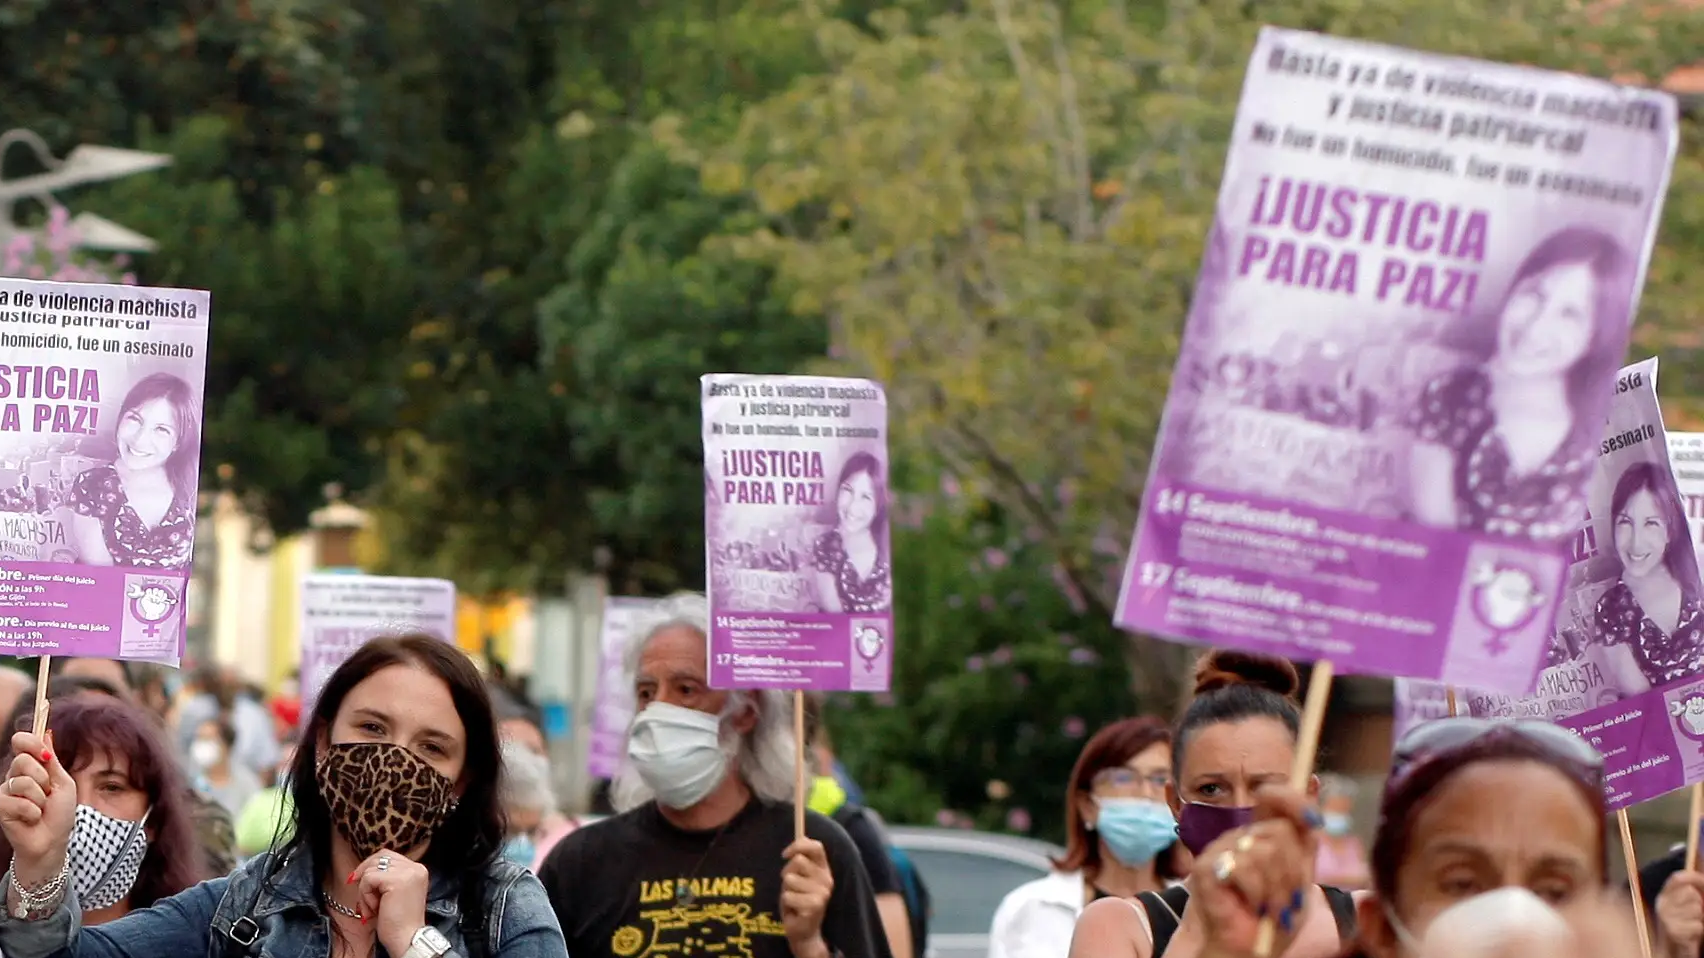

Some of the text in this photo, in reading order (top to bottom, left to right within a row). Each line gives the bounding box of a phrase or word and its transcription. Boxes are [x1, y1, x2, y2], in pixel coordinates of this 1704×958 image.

[1267, 44, 1662, 132] Basta ya de violencia machista
[1327, 96, 1585, 155] y justicia patriarcal
[1249, 175, 1492, 264] ¡JUSTICIA
[1238, 235, 1480, 317] PARA PAZ!
[13, 290, 33, 308] de
[39, 291, 114, 314] violencia
[119, 296, 197, 319] machista
[62, 313, 150, 331] patriarcal
[1, 331, 72, 351] homicidio,
[77, 335, 99, 351] fue
[103, 340, 120, 353] un
[124, 339, 194, 358] asesinato
[709, 383, 740, 396] Basta
[743, 385, 756, 397] ya
[760, 383, 773, 397] de
[776, 383, 825, 398] violencia
[33, 404, 99, 435] PAZ!
[722, 449, 824, 478] ¡JUSTICIA
[724, 480, 825, 506] PARA PAZ!
[21, 585, 33, 593] las
[34, 585, 46, 593] 9h
[27, 631, 43, 640] 19h
[640, 880, 673, 904] LAS
